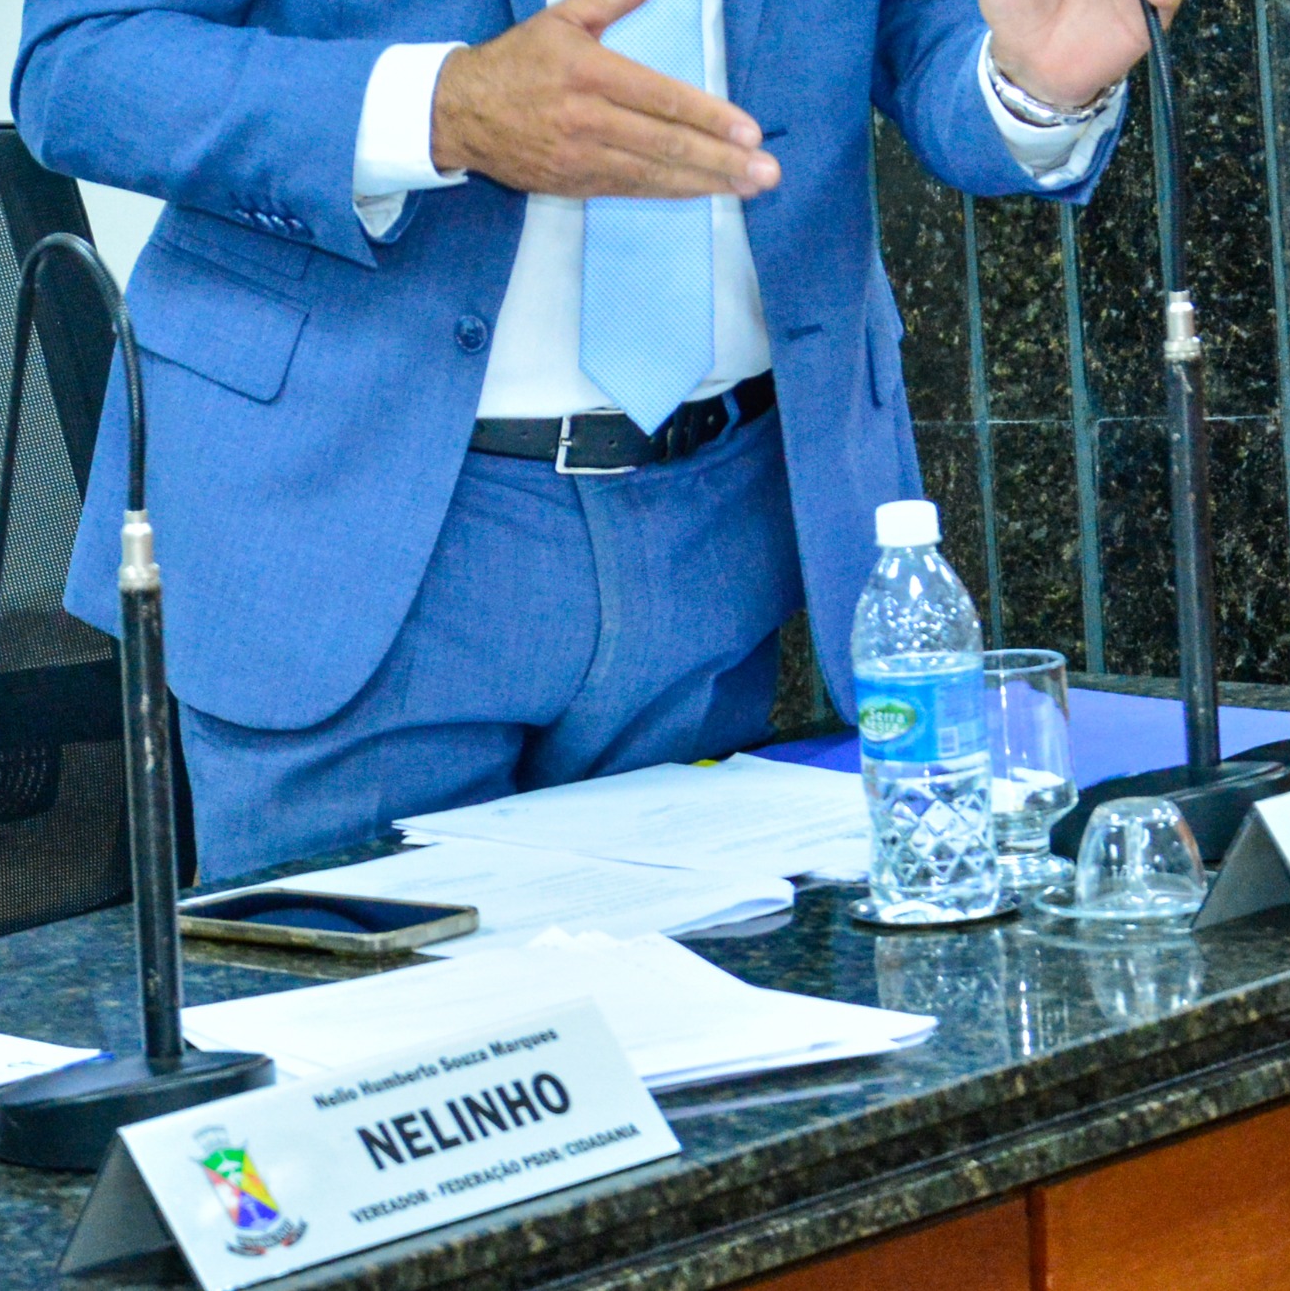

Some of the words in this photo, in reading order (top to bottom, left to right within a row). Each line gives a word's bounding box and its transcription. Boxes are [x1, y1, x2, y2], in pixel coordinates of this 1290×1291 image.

[358, 1063, 439, 1096] Humberto
[438, 1048, 489, 1072] Souza
[487, 1028, 558, 1057] Marques
[355, 1070, 572, 1170] NELINHO
[350, 1188, 430, 1223] VEREADOR
[437, 1158, 522, 1197] FEDERAÇÃO
